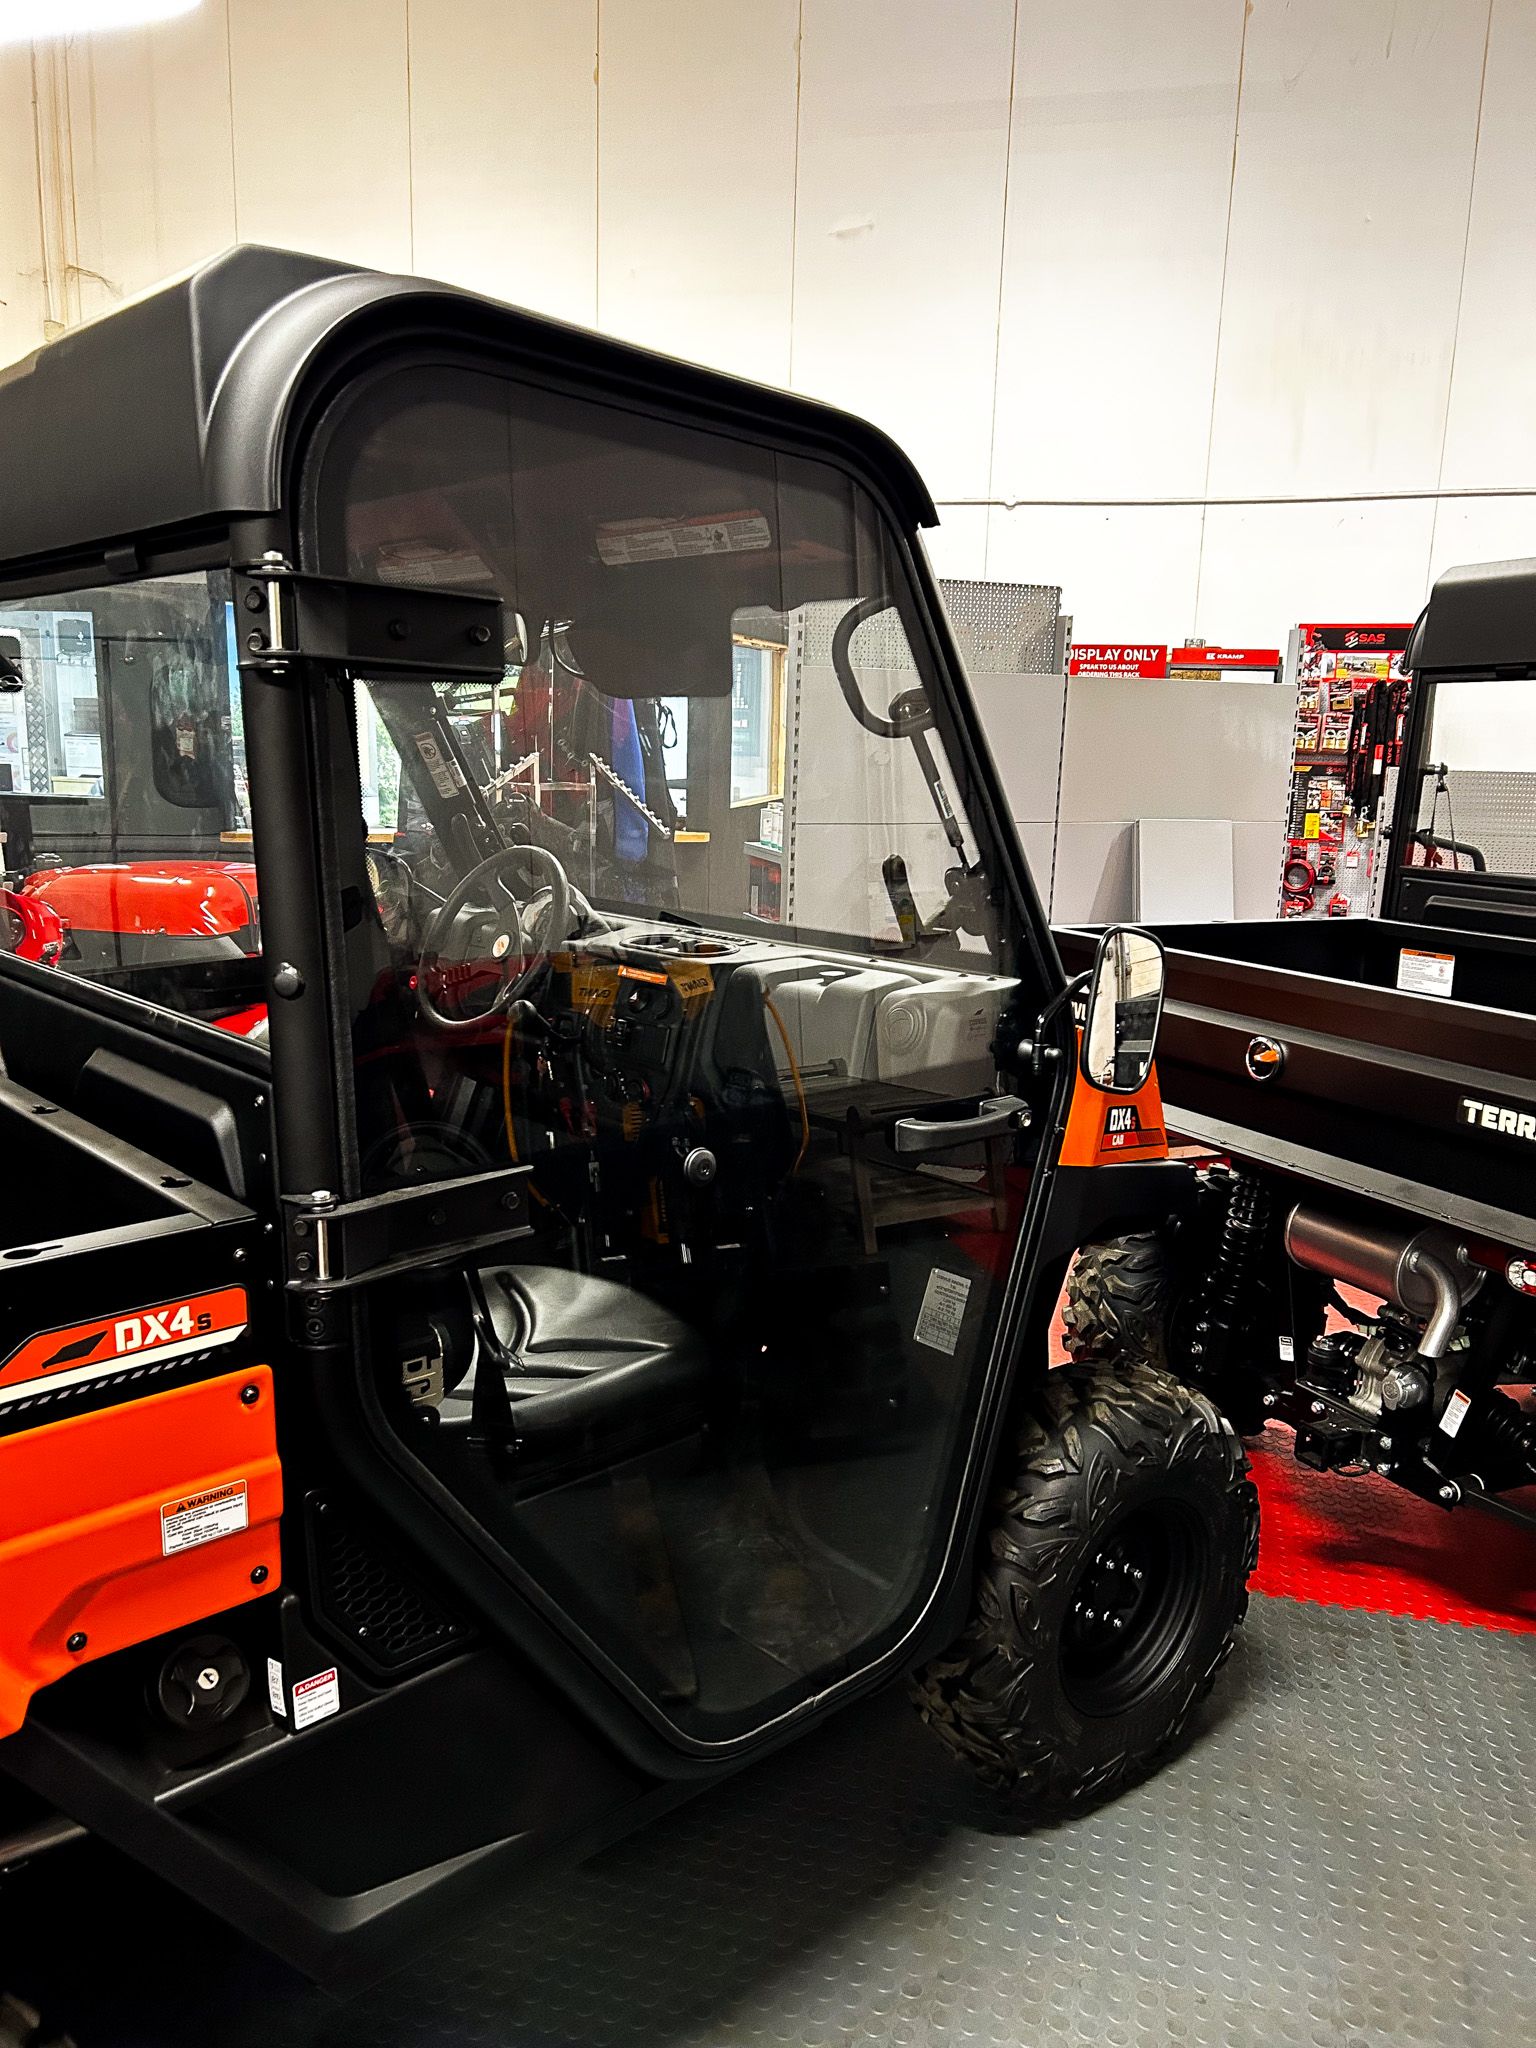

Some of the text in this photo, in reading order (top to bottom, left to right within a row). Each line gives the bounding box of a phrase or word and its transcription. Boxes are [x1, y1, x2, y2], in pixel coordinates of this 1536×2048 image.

[1359, 633, 1386, 643] SAS
[1123, 648, 1159, 661] ONLY
[1463, 1098, 1536, 1140] TERR
[186, 1487, 234, 1509] WARNING
[304, 1673, 334, 1690] DANGER
